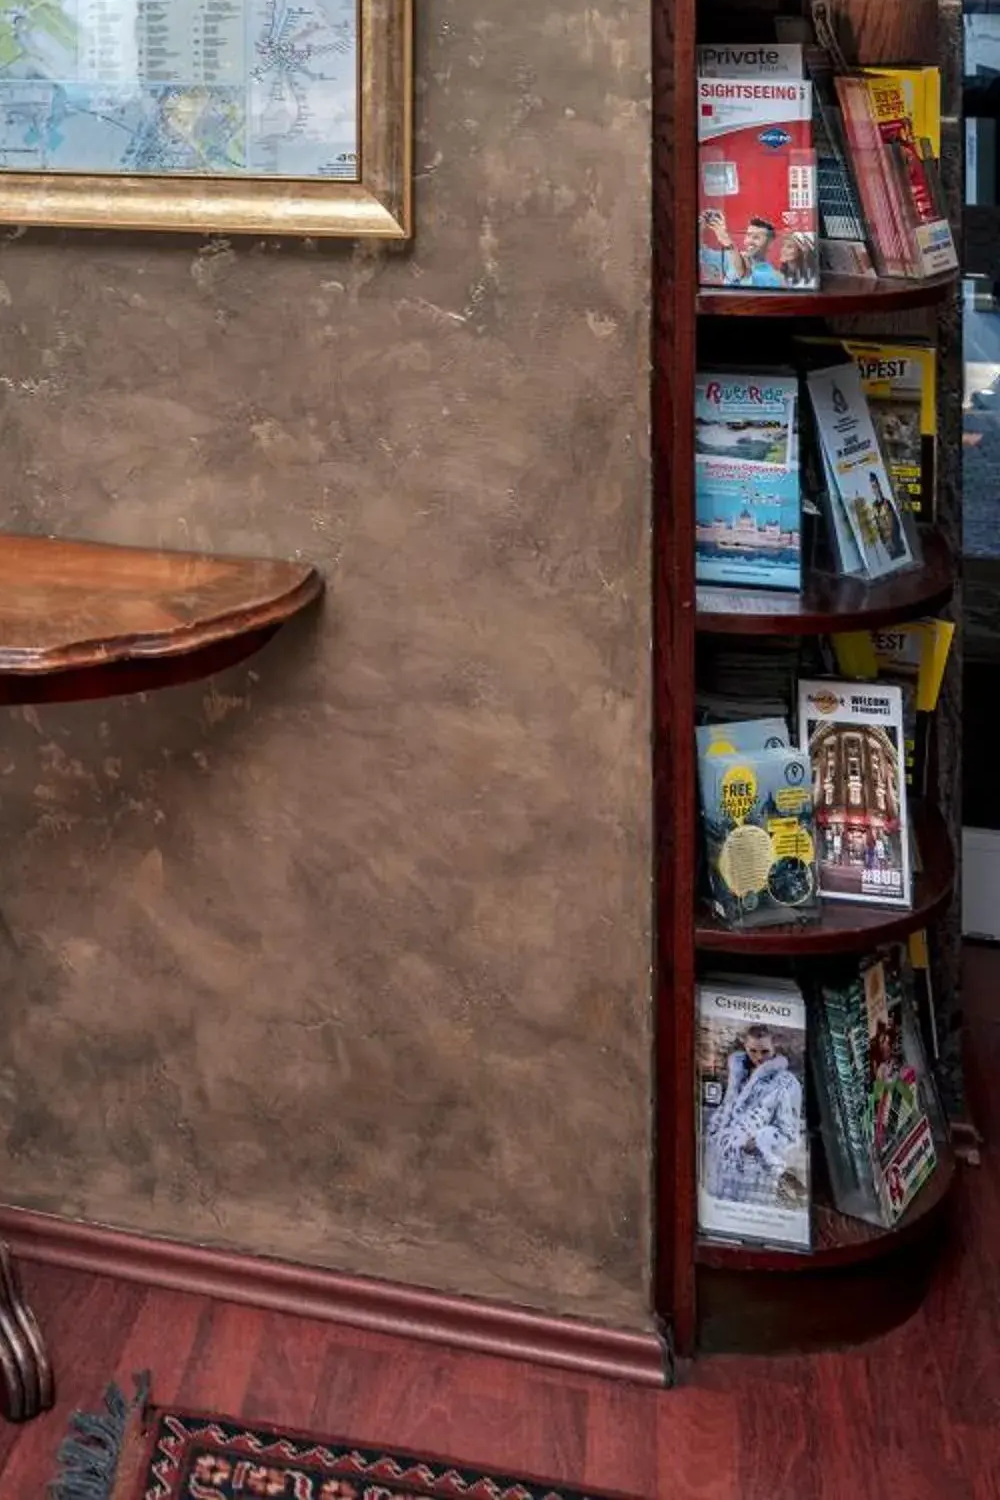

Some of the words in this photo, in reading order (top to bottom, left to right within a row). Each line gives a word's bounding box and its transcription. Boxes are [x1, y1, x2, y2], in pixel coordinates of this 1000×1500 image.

[703, 47, 779, 65] Private
[701, 84, 796, 101] SIGHTSEEING
[851, 695, 890, 707] WELCOME
[723, 783, 753, 798] FREE
